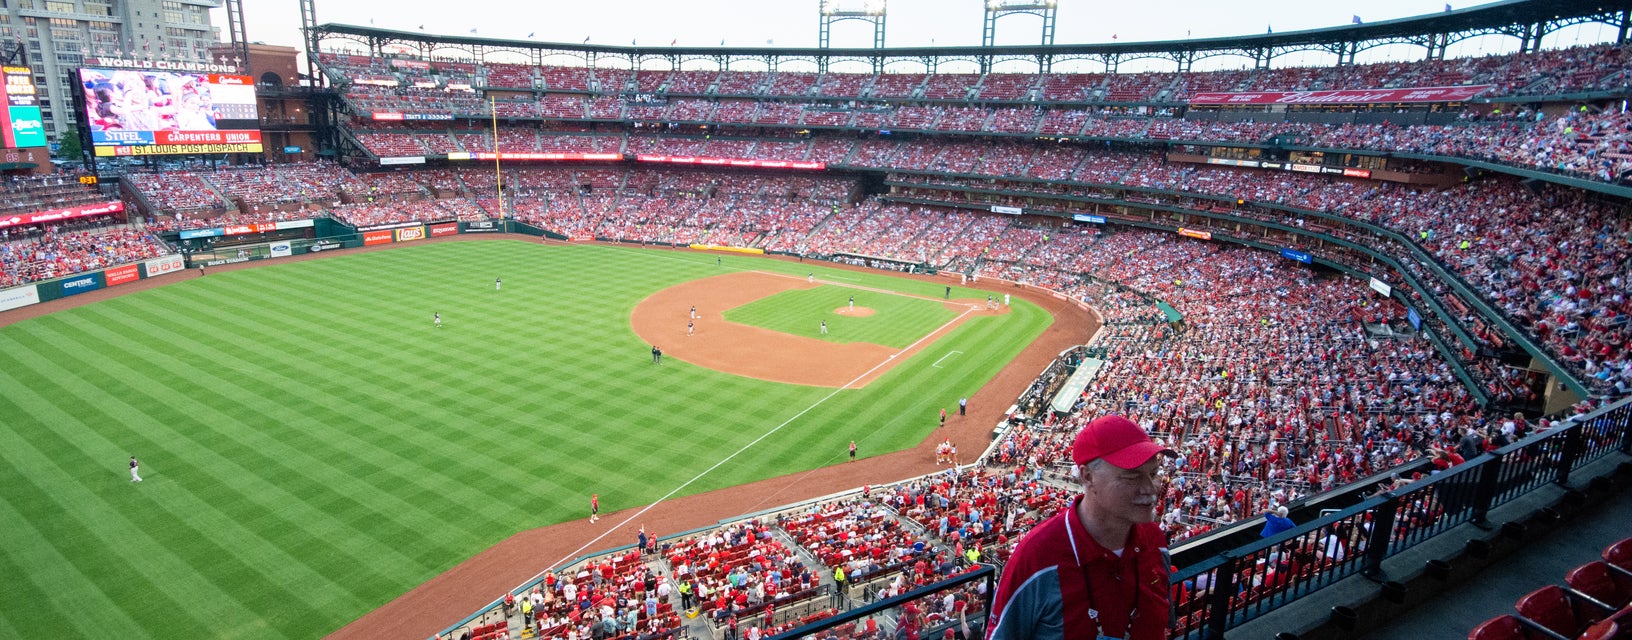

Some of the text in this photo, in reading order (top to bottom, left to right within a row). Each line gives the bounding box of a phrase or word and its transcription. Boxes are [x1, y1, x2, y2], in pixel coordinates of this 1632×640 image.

[97, 57, 236, 73] WORLD CHAMPIONS
[1275, 91, 1394, 103] Budweiser
[105, 131, 142, 141] STIFEL
[168, 133, 249, 142] CARPENTERS UNION
[135, 143, 248, 154] ST. LOUIS POST-DISPATCH
[6, 153, 19, 162] 85
